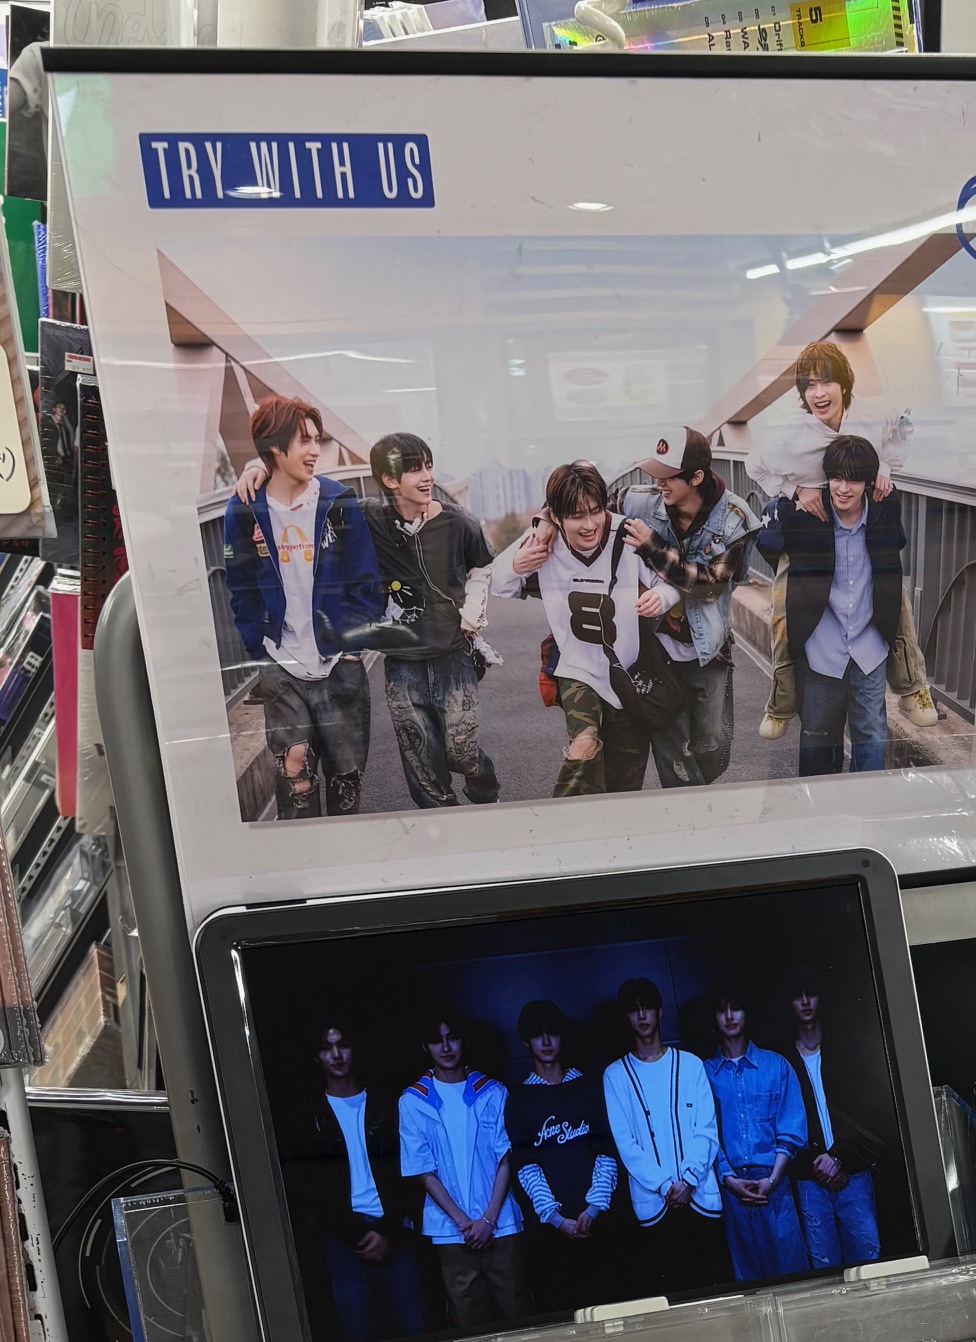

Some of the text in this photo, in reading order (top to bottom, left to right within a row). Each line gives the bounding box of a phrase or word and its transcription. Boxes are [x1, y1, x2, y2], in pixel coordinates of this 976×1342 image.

[795, 7, 806, 48] TRACKS
[809, 6, 823, 24] 5
[150, 140, 424, 200] TRY WITH US
